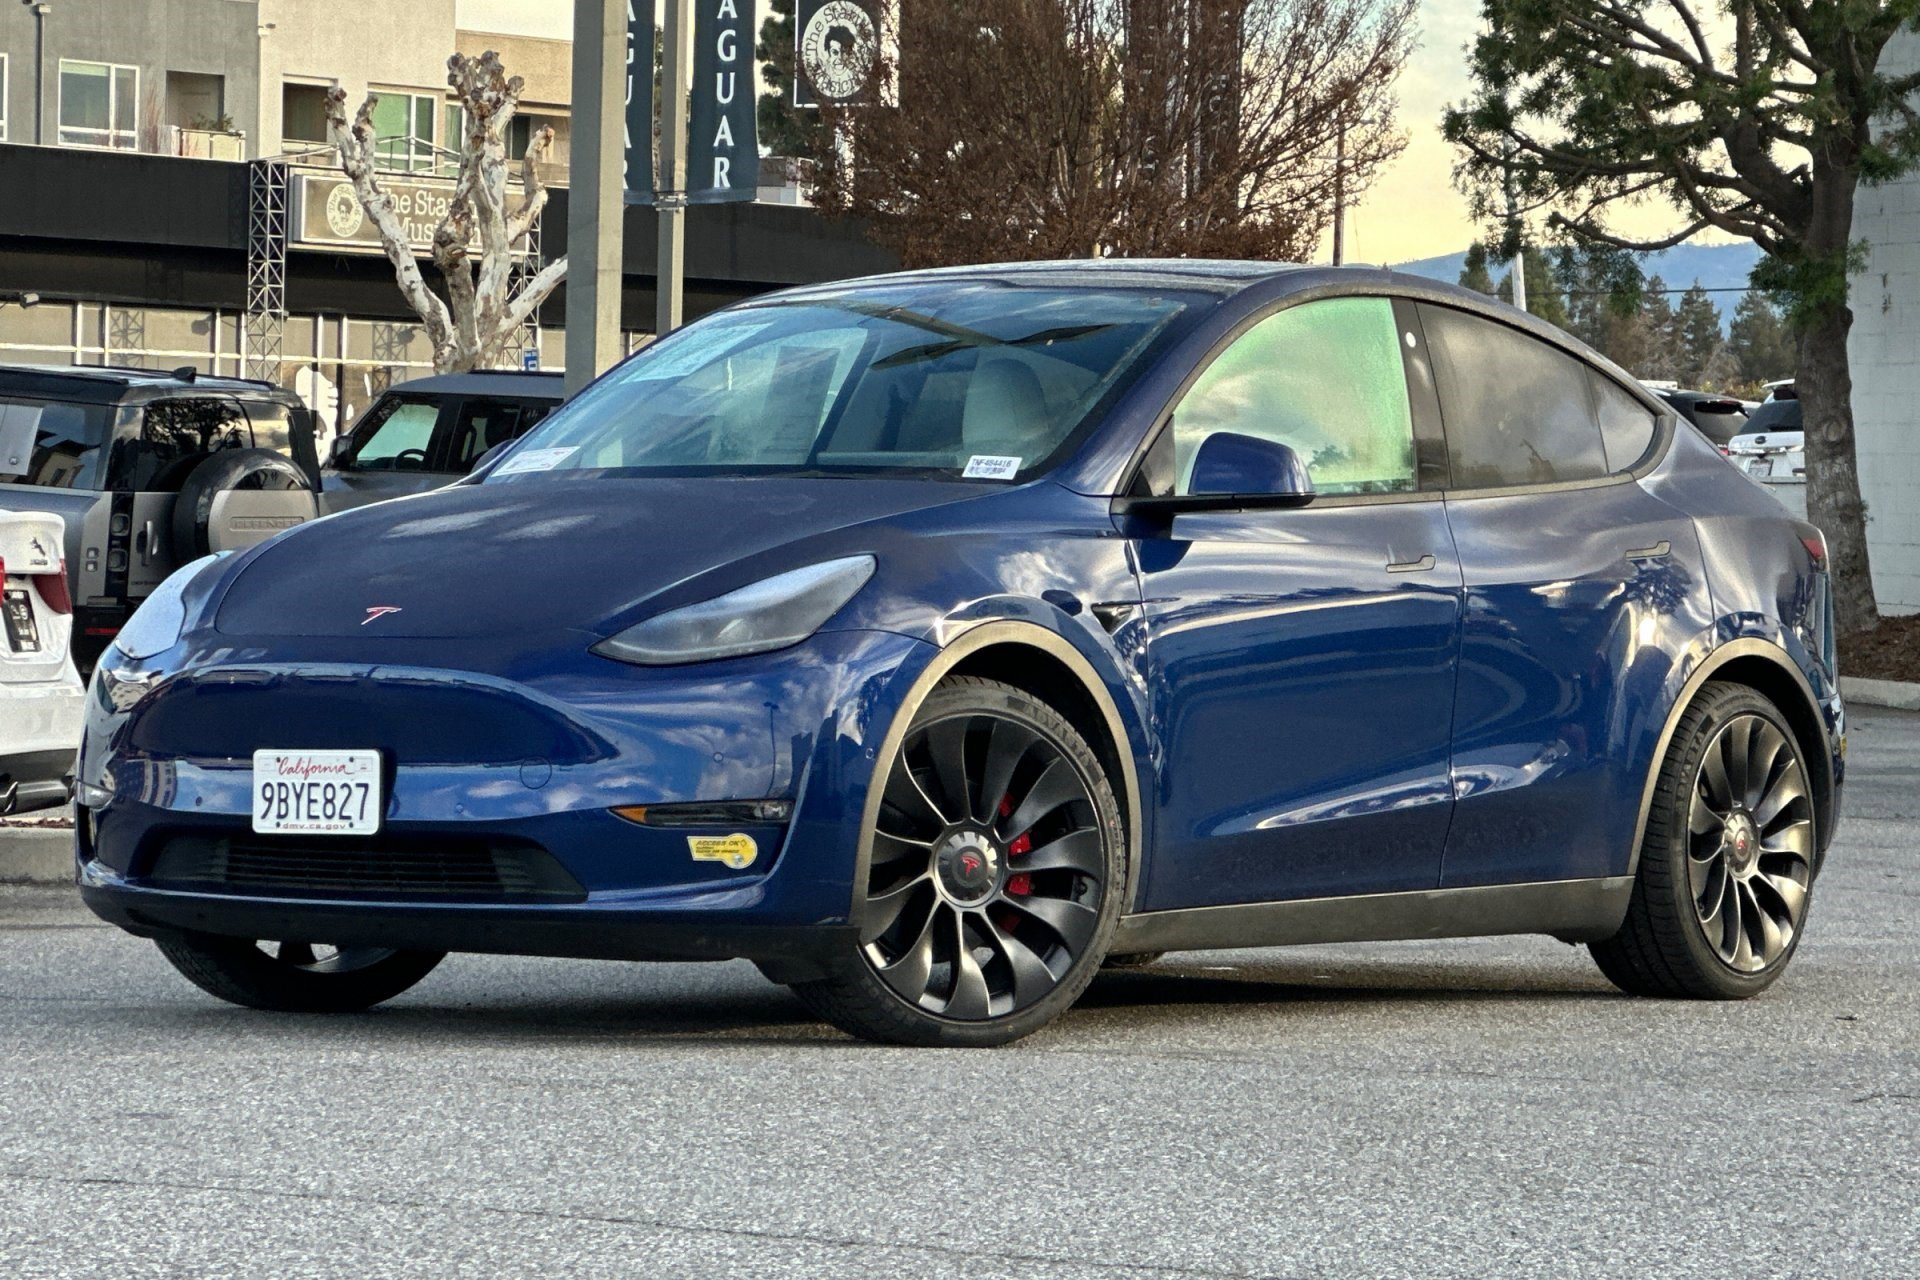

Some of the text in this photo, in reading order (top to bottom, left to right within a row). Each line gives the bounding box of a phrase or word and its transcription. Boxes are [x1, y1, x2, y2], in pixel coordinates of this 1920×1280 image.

[805, 20, 824, 57] The
[379, 187, 411, 214] he
[279, 757, 355, 780] California
[261, 782, 369, 820] 9BYE827
[282, 822, 346, 830] dmv.ca.gov
